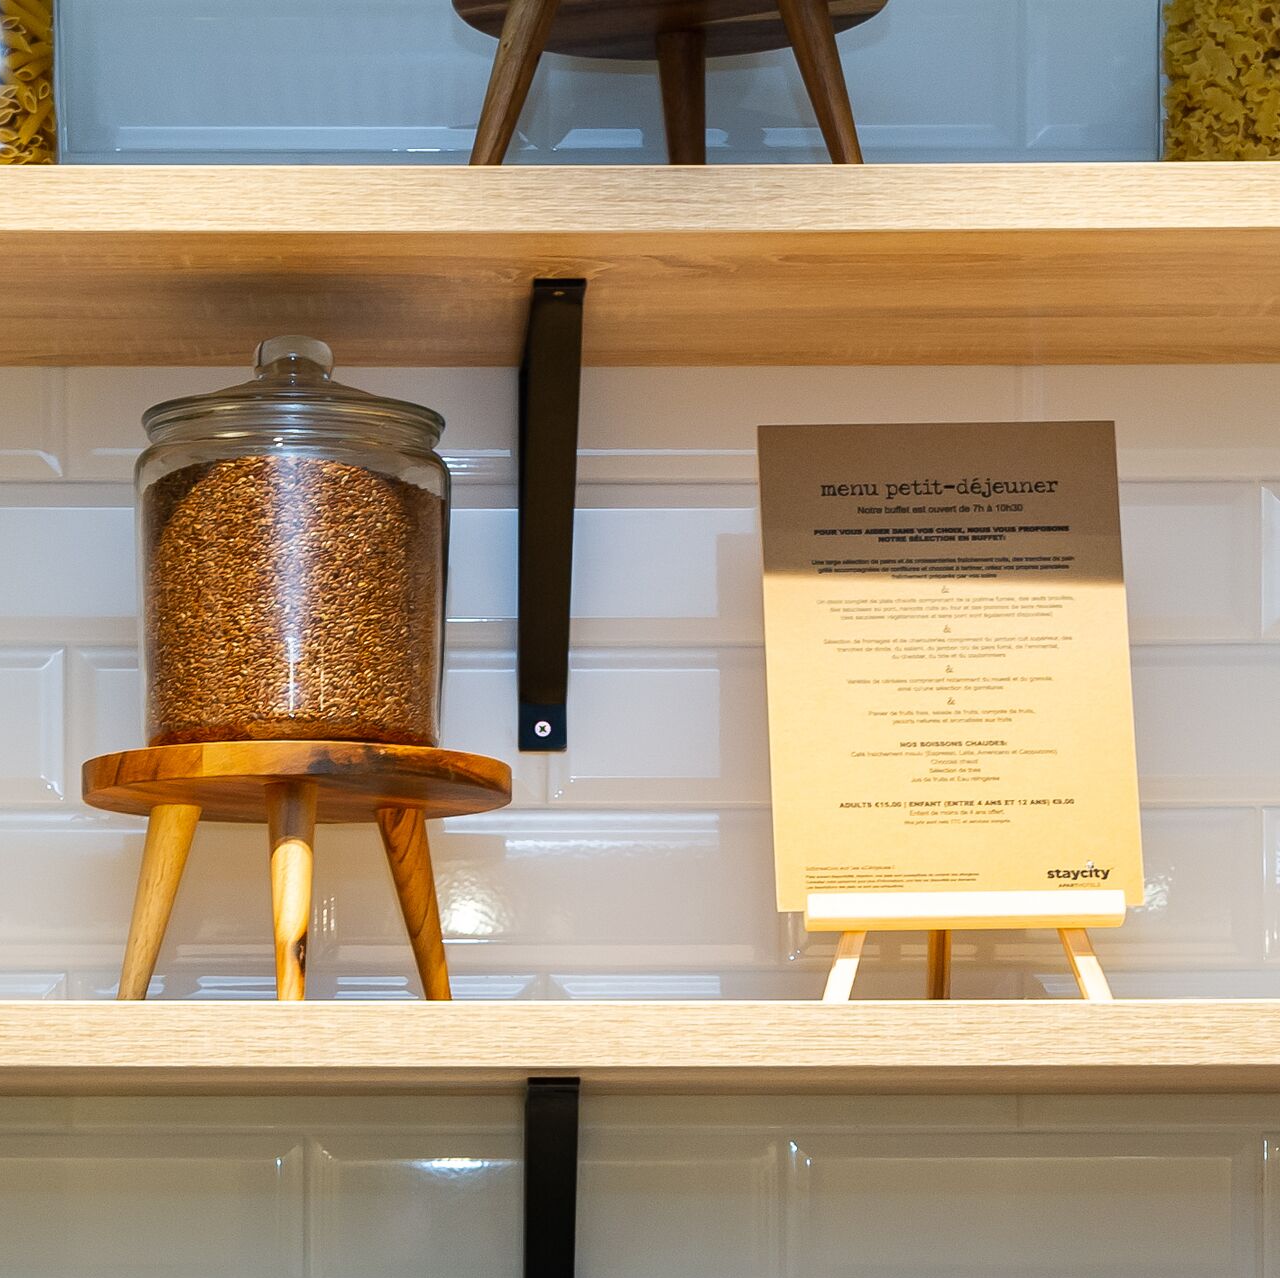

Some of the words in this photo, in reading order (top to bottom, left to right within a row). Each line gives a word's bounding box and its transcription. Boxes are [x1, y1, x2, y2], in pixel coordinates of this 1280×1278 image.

[820, 483, 879, 497] menu
[885, 478, 1059, 500] petit-déjeuner
[857, 506, 882, 514] Notre
[884, 505, 910, 514] buffet
[928, 505, 957, 513] ouvert
[959, 504, 970, 512] de
[973, 504, 984, 512] 7h
[995, 503, 1024, 511] 10h30
[814, 528, 838, 536] POUR
[1047, 865, 1112, 880] staycity
